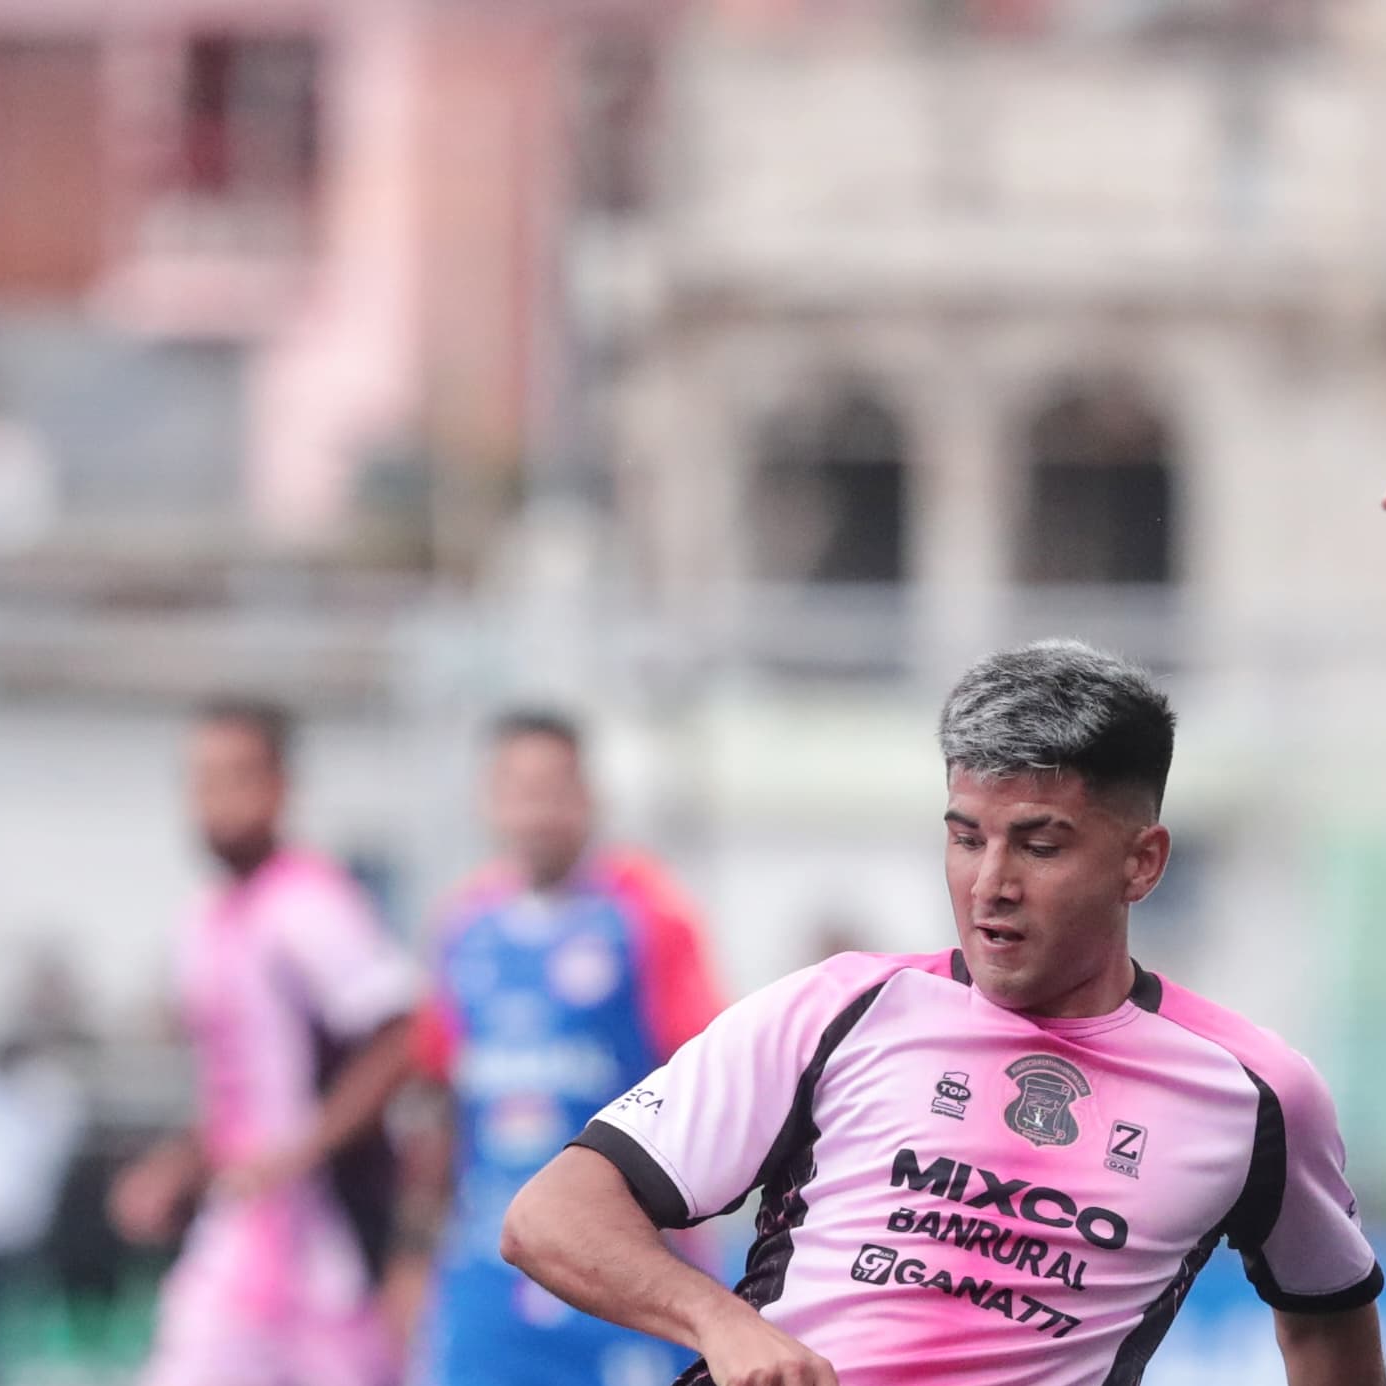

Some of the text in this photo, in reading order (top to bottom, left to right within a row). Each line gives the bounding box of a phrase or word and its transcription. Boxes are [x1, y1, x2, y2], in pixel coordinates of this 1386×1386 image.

[940, 1083, 969, 1097] TOP
[1111, 1124, 1142, 1161] Z
[890, 1148, 1129, 1251] MIXCO
[887, 1207, 1088, 1292] BANRURAL
[894, 1258, 1082, 1338] GANA777
